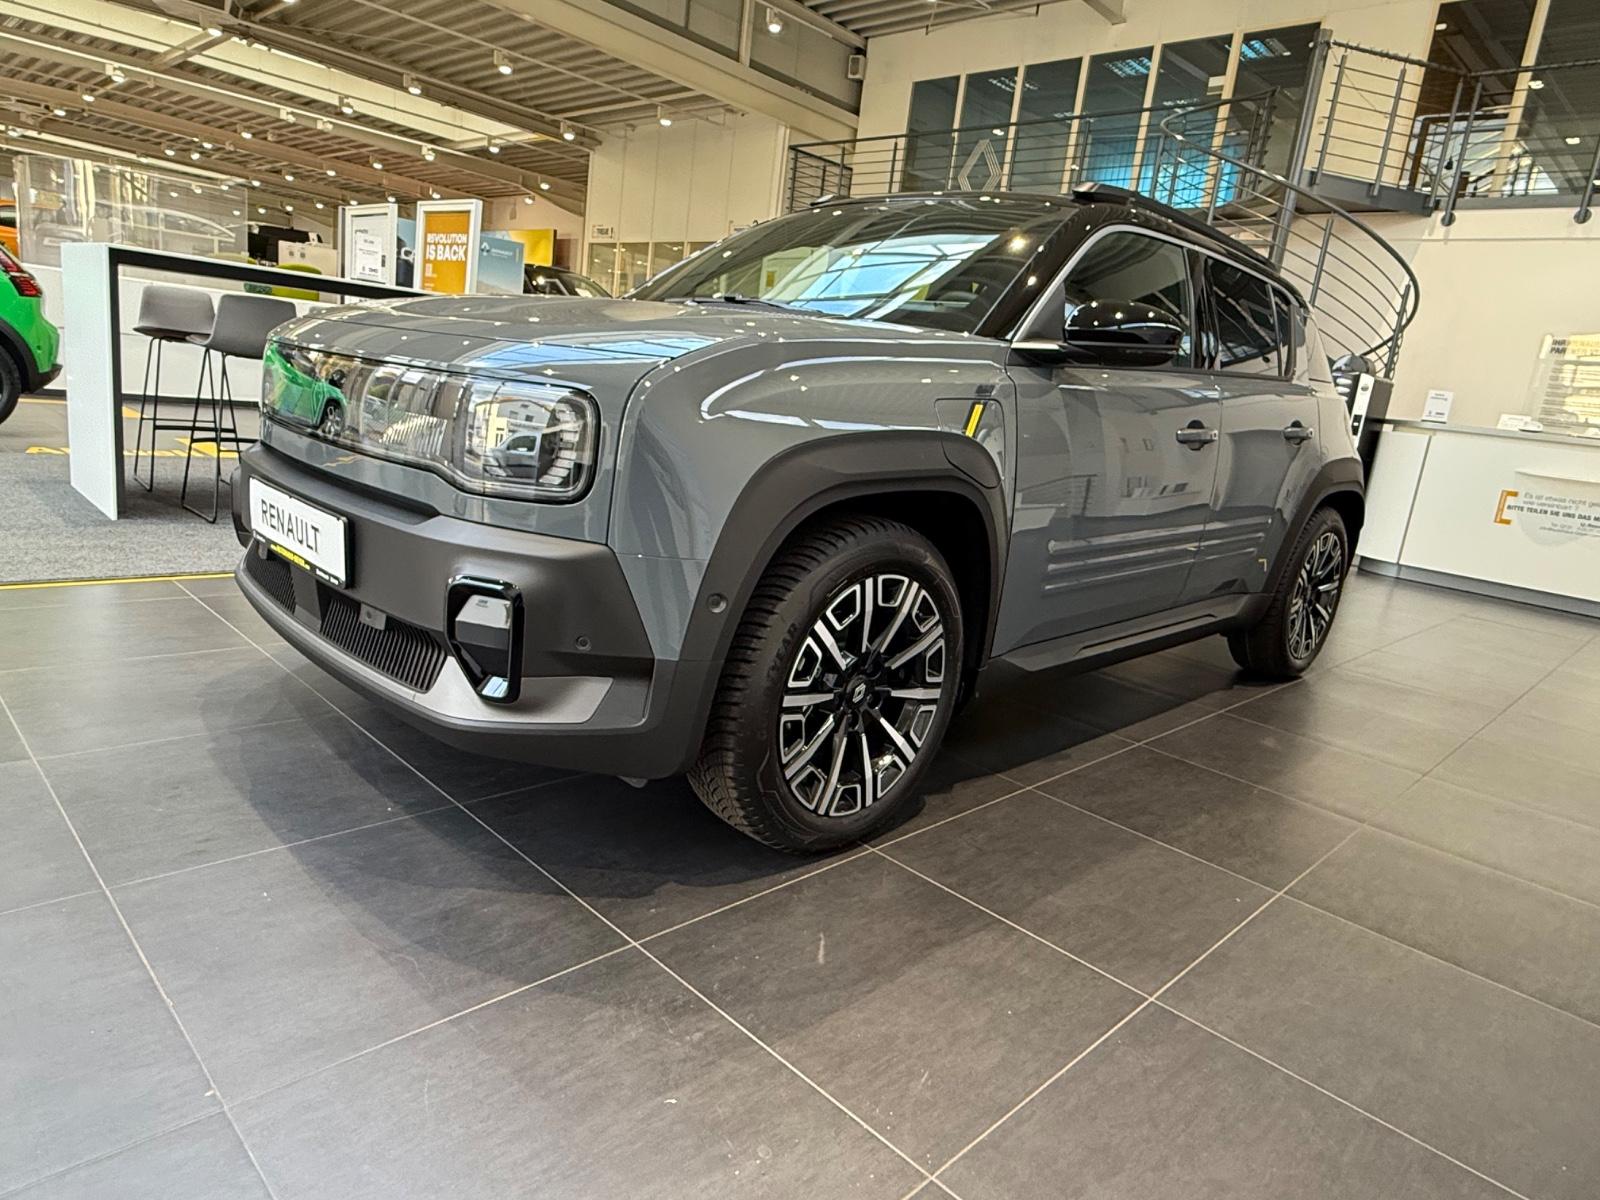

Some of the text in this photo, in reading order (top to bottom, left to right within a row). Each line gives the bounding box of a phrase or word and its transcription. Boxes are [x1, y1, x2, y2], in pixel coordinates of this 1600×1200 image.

[427, 233, 467, 243] REVOLUTION
[426, 245, 436, 260] IS
[437, 245, 466, 261] BACK
[1577, 513, 1592, 521] DAS
[261, 498, 319, 554] RENAULT
